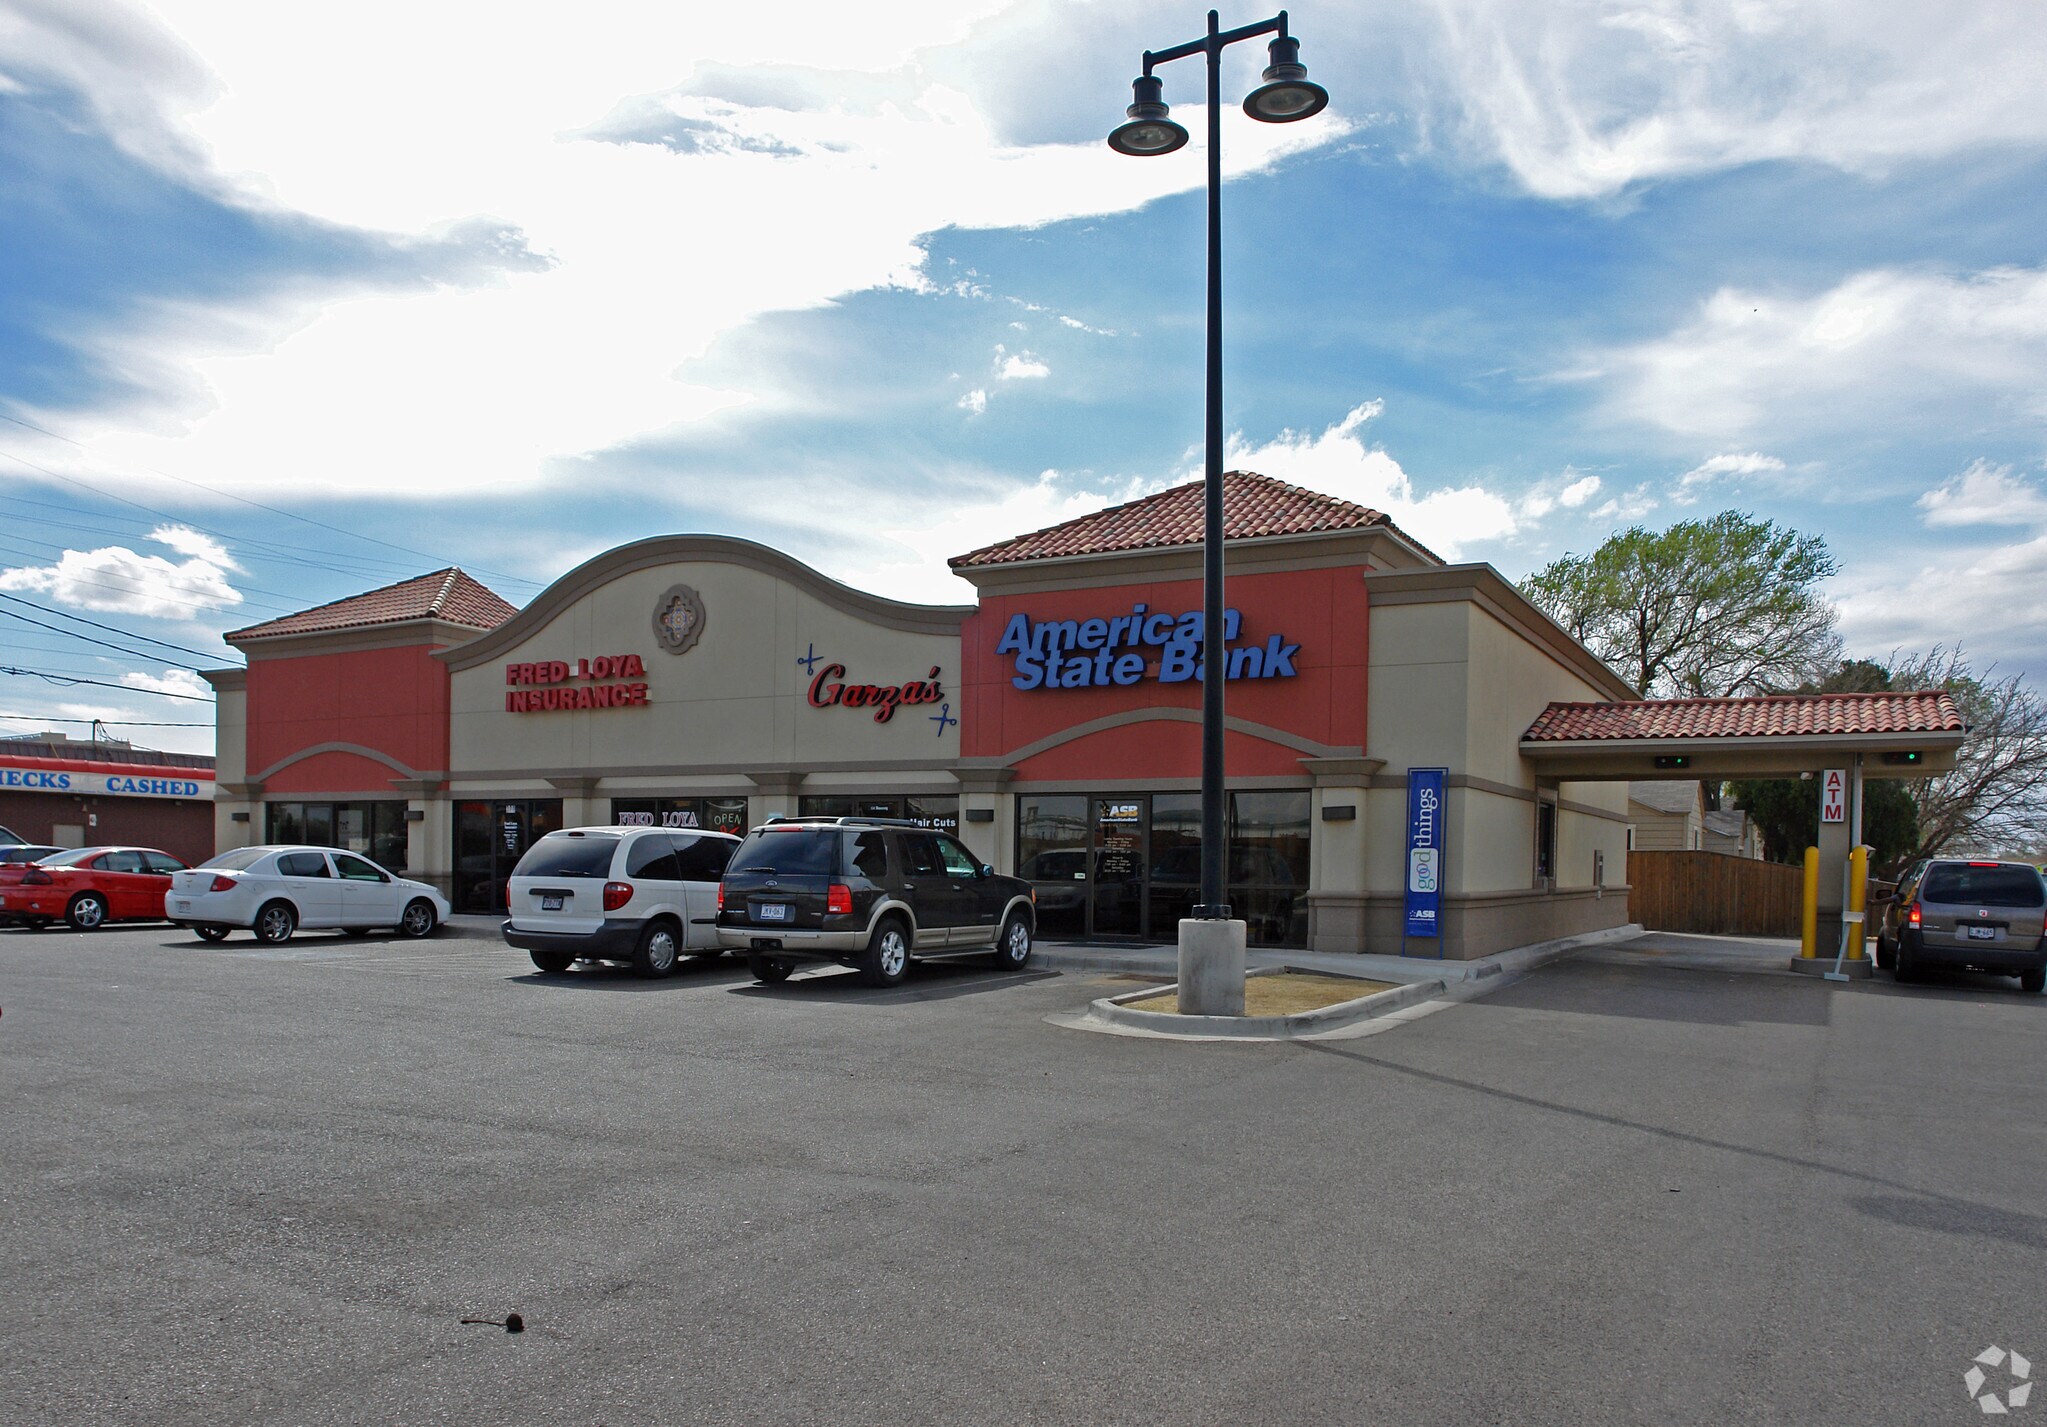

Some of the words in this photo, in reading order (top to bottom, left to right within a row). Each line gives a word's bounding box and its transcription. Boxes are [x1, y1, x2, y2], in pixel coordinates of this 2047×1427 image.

[996, 603, 1242, 654] American
[506, 660, 570, 686] FRED
[577, 654, 646, 681] LOYA
[1011, 647, 1144, 691] State
[505, 682, 649, 713] INSURANCE
[807, 663, 945, 724] Garza's
[106, 777, 200, 796] CASHED
[1825, 771, 1842, 820] ATM
[618, 811, 655, 826] FRED
[661, 811, 699, 827] LOYA
[713, 812, 742, 825] OPEN
[933, 818, 956, 827] Cuts
[1109, 805, 1138, 817] ASB
[1413, 788, 1438, 848] things
[1414, 849, 1436, 891] good
[1416, 910, 1435, 918] ASB
